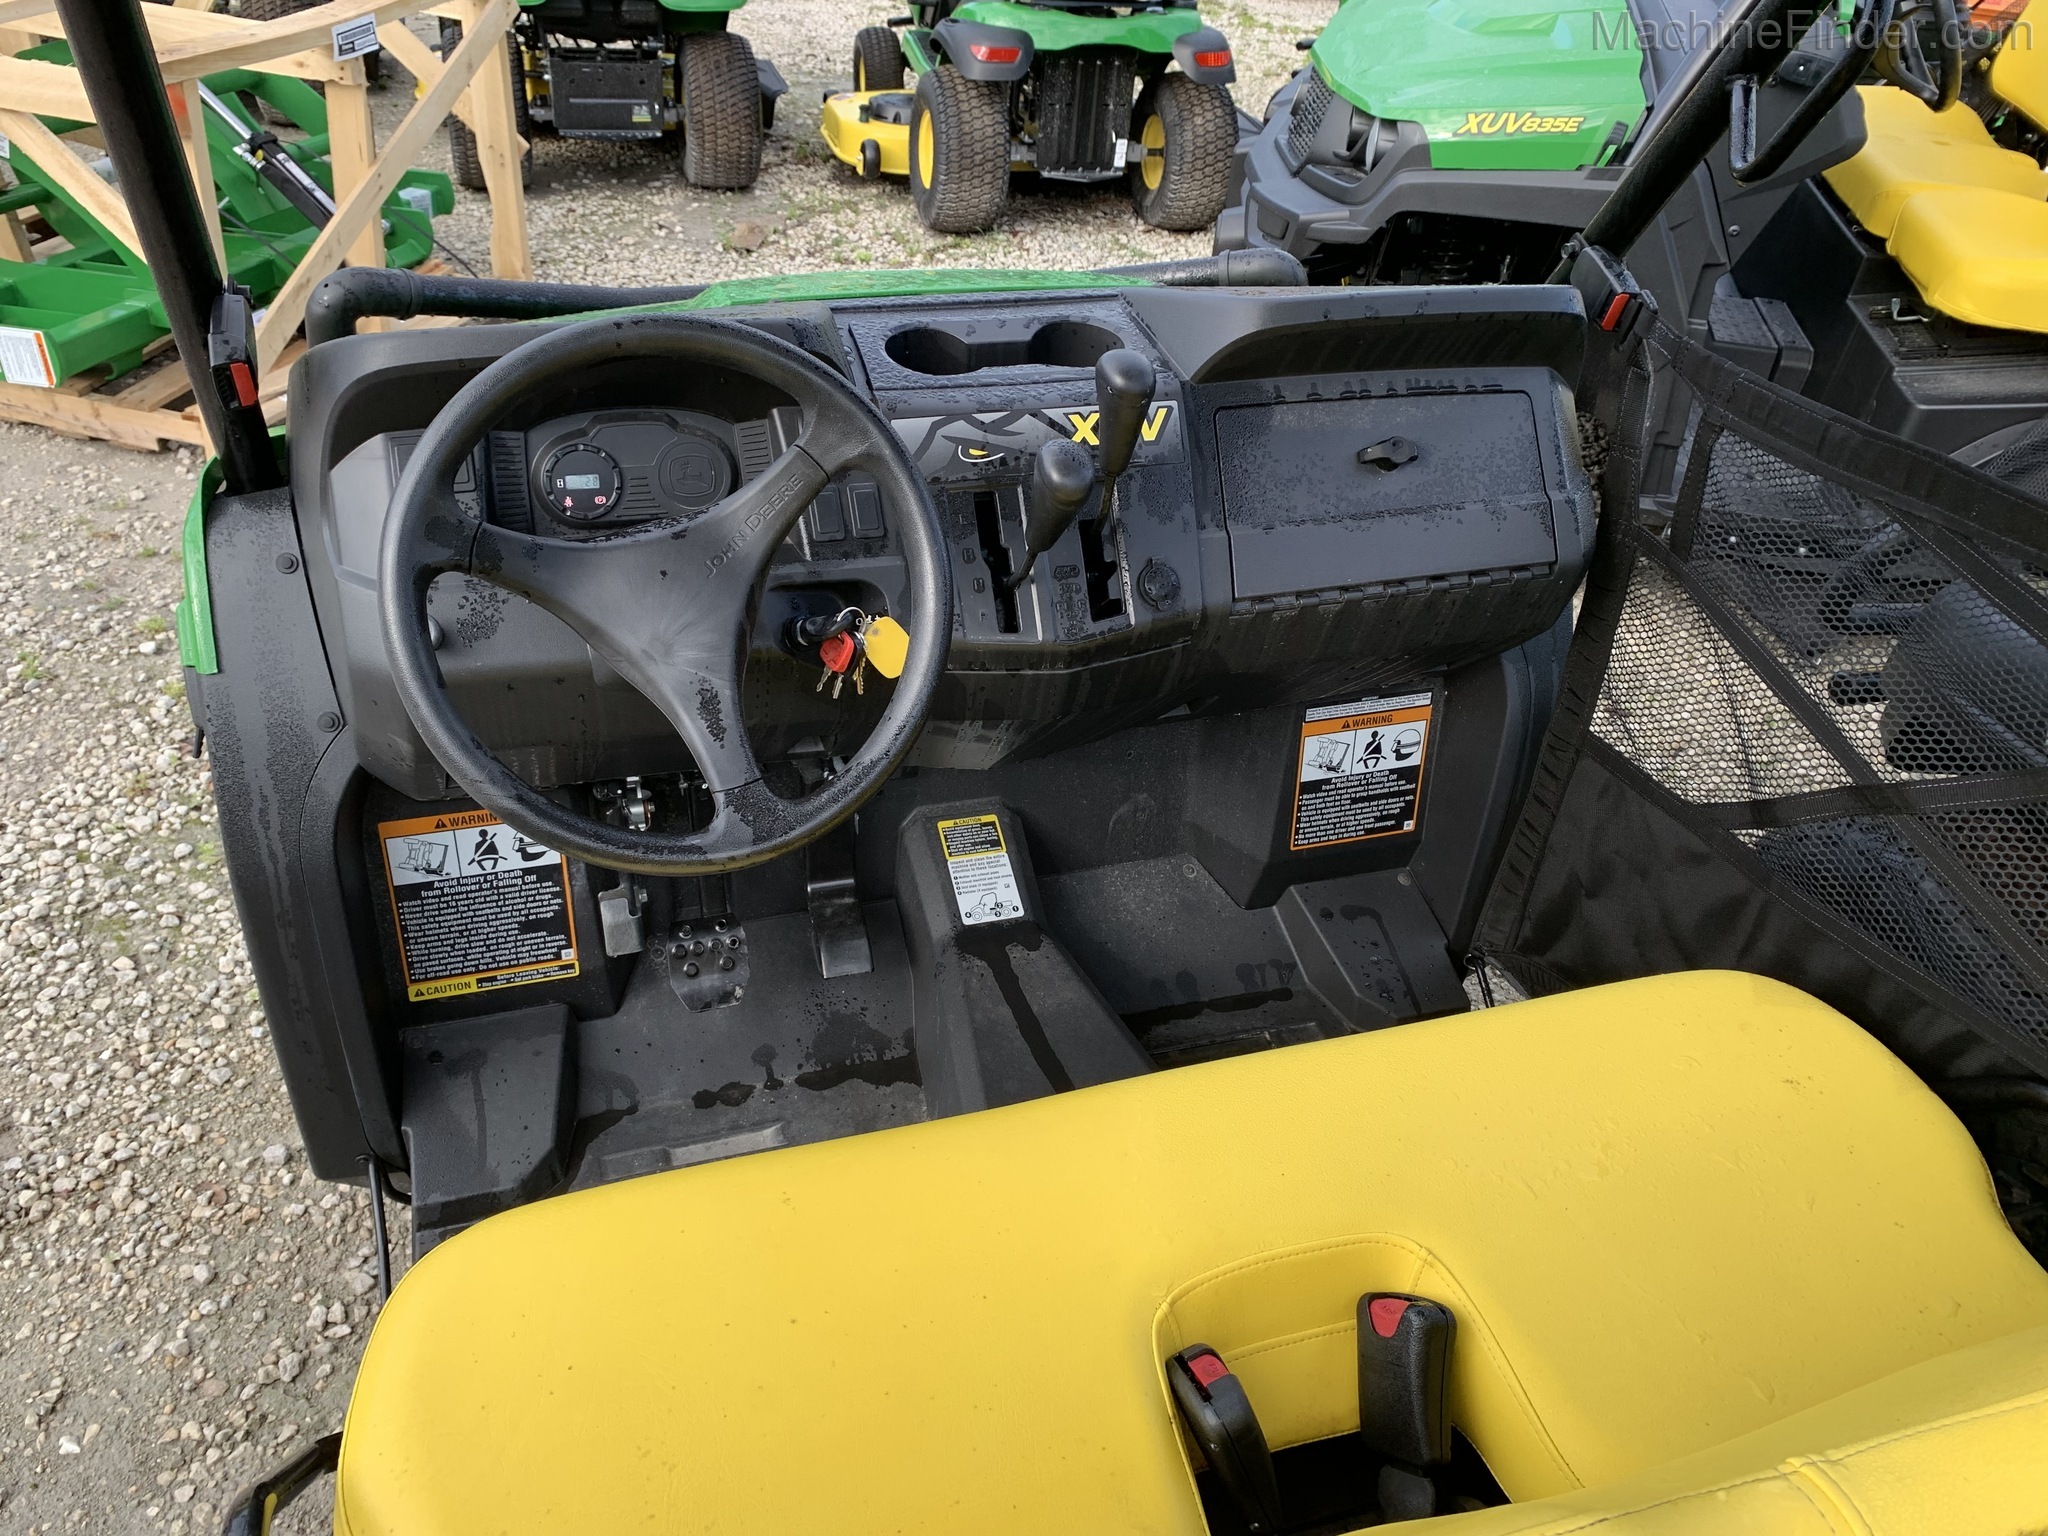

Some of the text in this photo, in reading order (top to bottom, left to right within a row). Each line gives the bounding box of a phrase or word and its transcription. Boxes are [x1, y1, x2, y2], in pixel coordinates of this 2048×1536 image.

[1064, 406, 1172, 446] XV
[704, 474, 804, 579] JOHN DEERE
[1352, 714, 1393, 728] WARNING
[1336, 780, 1360, 788] Rollover
[1368, 776, 1388, 784] Falling
[1348, 774, 1364, 782] Injury
[448, 813, 500, 828] WARNIN
[958, 817, 982, 825] CAUTION
[421, 888, 441, 897] from
[444, 883, 480, 894] Rollover
[493, 877, 522, 889] Falling
[524, 875, 537, 883] Off
[434, 878, 458, 888] Avoid
[460, 875, 485, 886] Injury
[498, 869, 523, 879] Death
[426, 981, 472, 996] CAUTION
